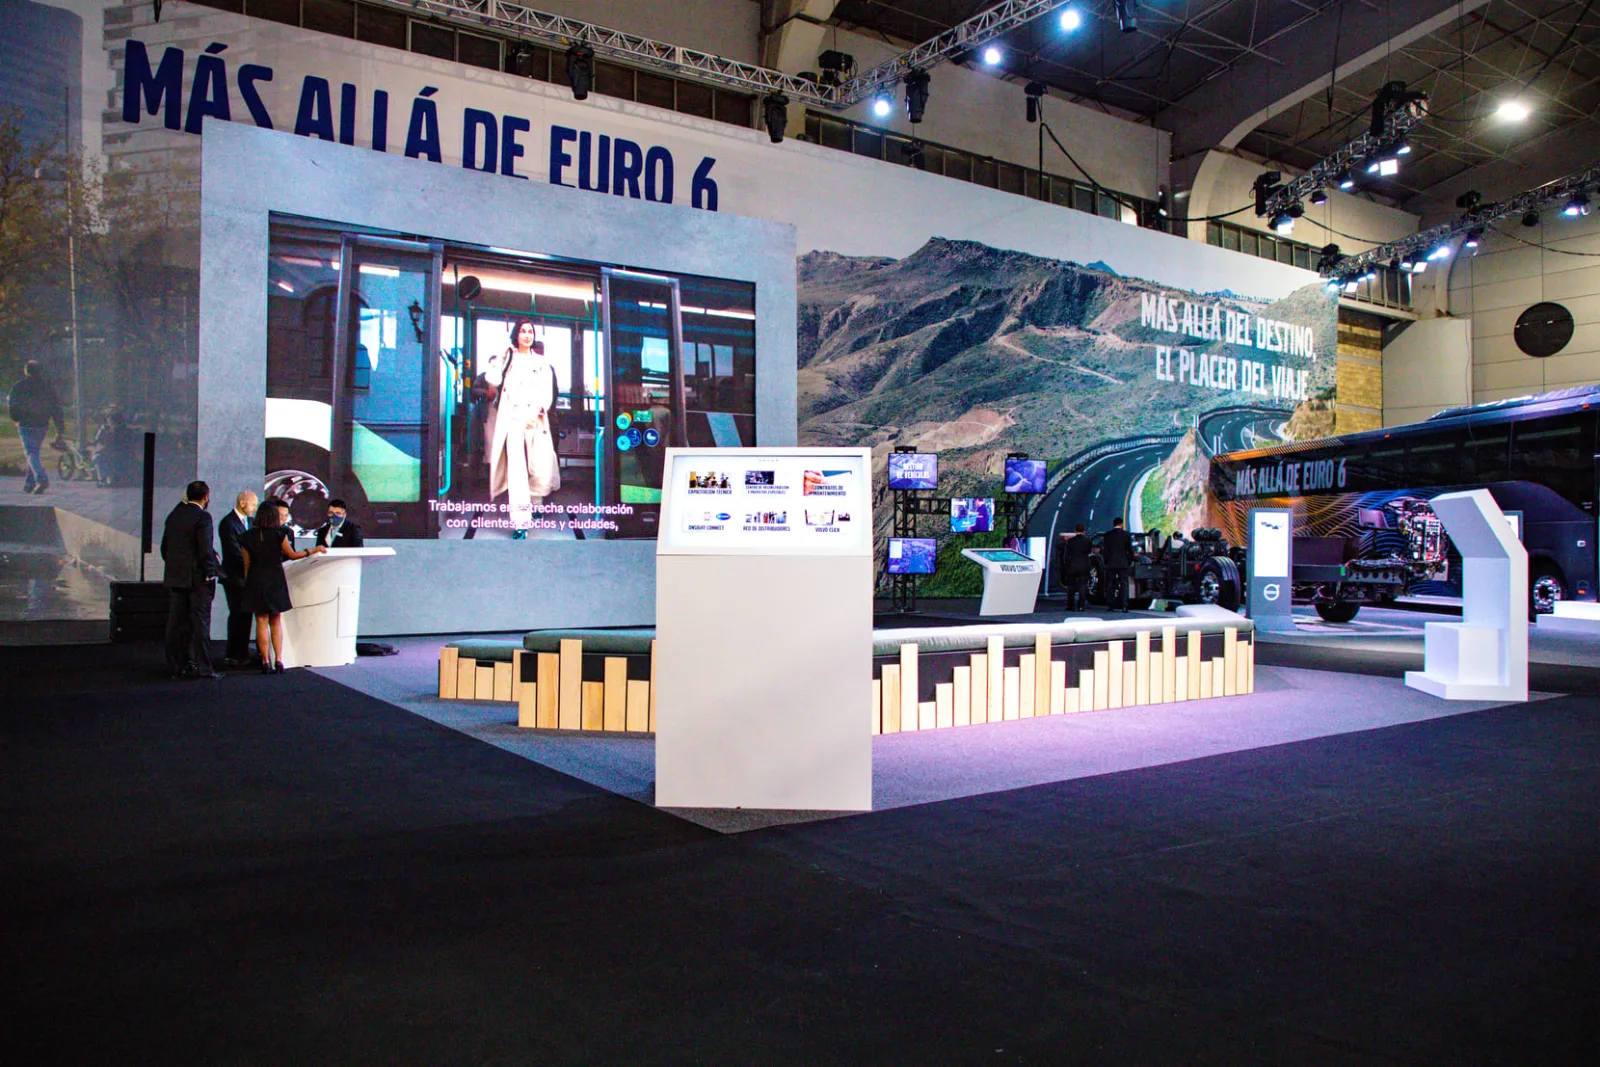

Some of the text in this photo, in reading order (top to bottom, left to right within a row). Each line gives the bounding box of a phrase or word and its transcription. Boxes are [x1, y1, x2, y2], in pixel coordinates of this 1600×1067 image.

[122, 39, 273, 135] MÁS
[462, 107, 530, 180] DE
[550, 125, 674, 204] EURO
[691, 156, 718, 212] 6
[1141, 292, 1317, 362] MÁS ALLÁ DEL DESTINO,
[1156, 345, 1175, 382] EL
[1179, 349, 1237, 390] PLACER
[1242, 359, 1268, 396] DEL
[1235, 458, 1347, 495] MÁS ALLÁ DE EURO 6
[428, 500, 497, 513] Trabajamos
[566, 503, 634, 515] colaboración
[446, 518, 468, 528] con
[559, 519, 566, 531] y
[568, 517, 619, 532] ciudades,
